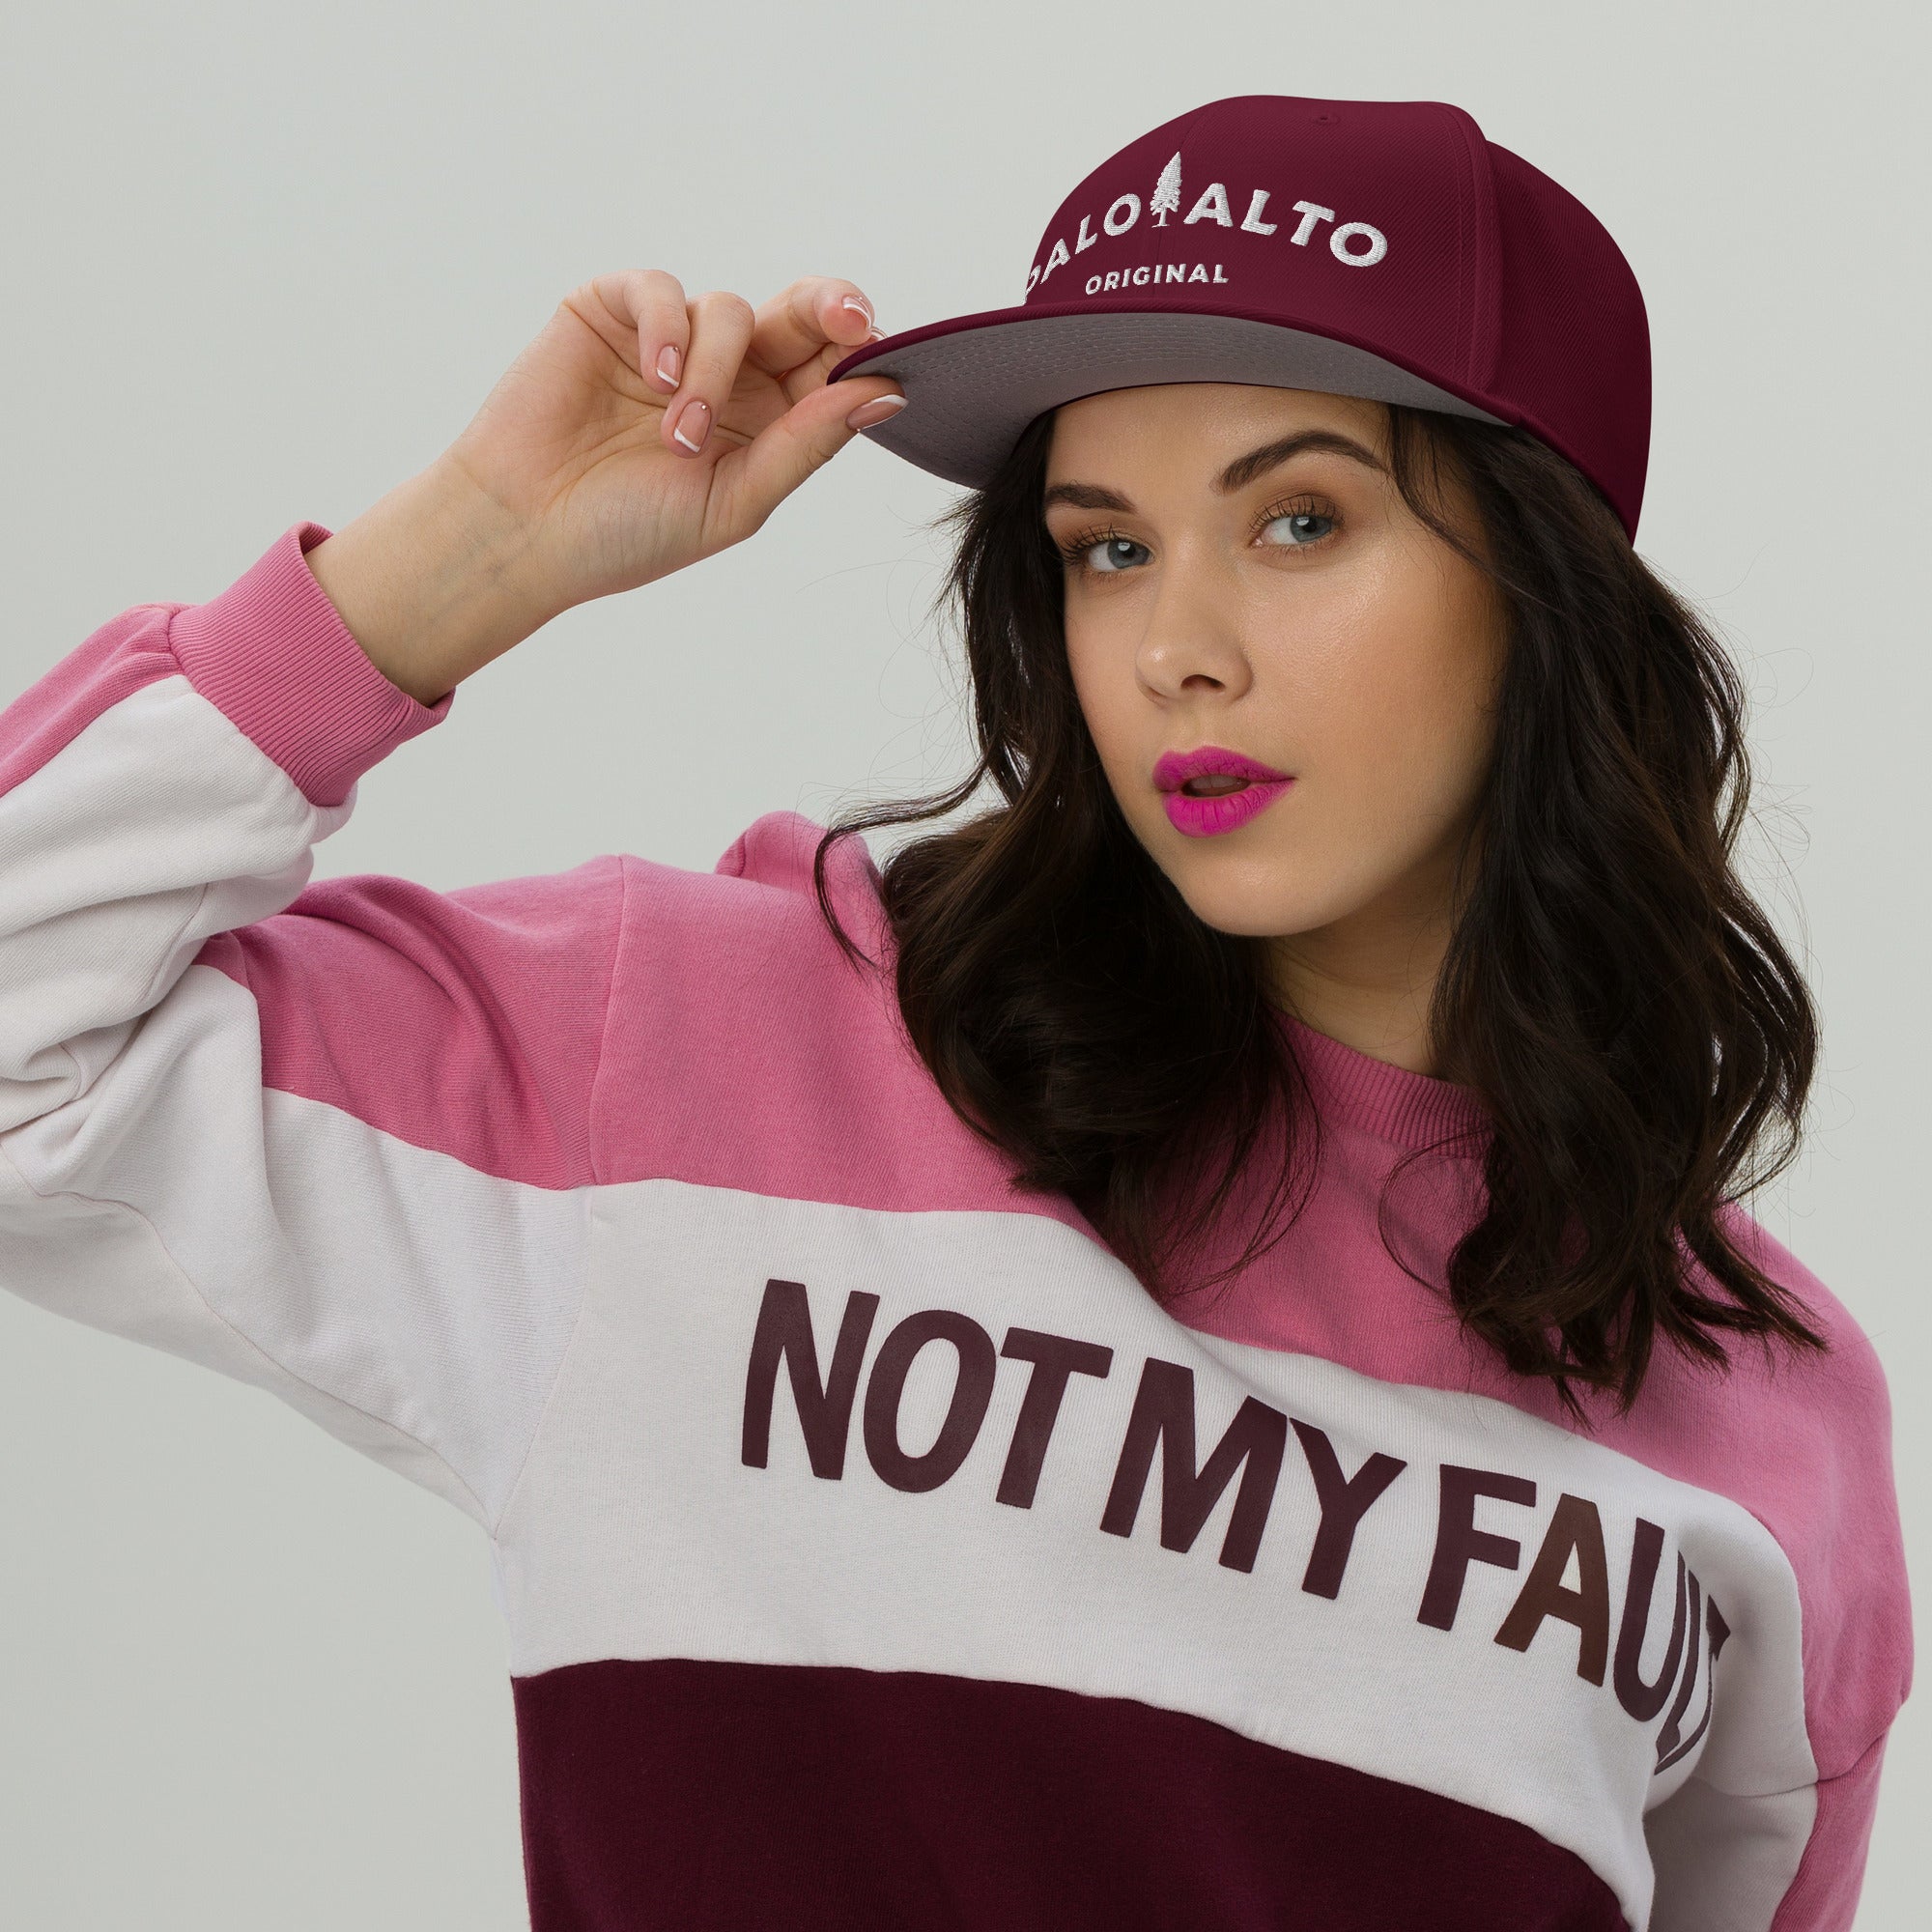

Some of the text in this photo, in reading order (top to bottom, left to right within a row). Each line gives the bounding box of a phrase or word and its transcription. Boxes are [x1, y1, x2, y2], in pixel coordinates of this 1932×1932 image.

[1183, 183, 1388, 267] ALTO
[1085, 263, 1229, 295] ORIGINAL
[742, 1278, 1114, 1509] NOT
[1099, 1356, 1407, 1601] MY
